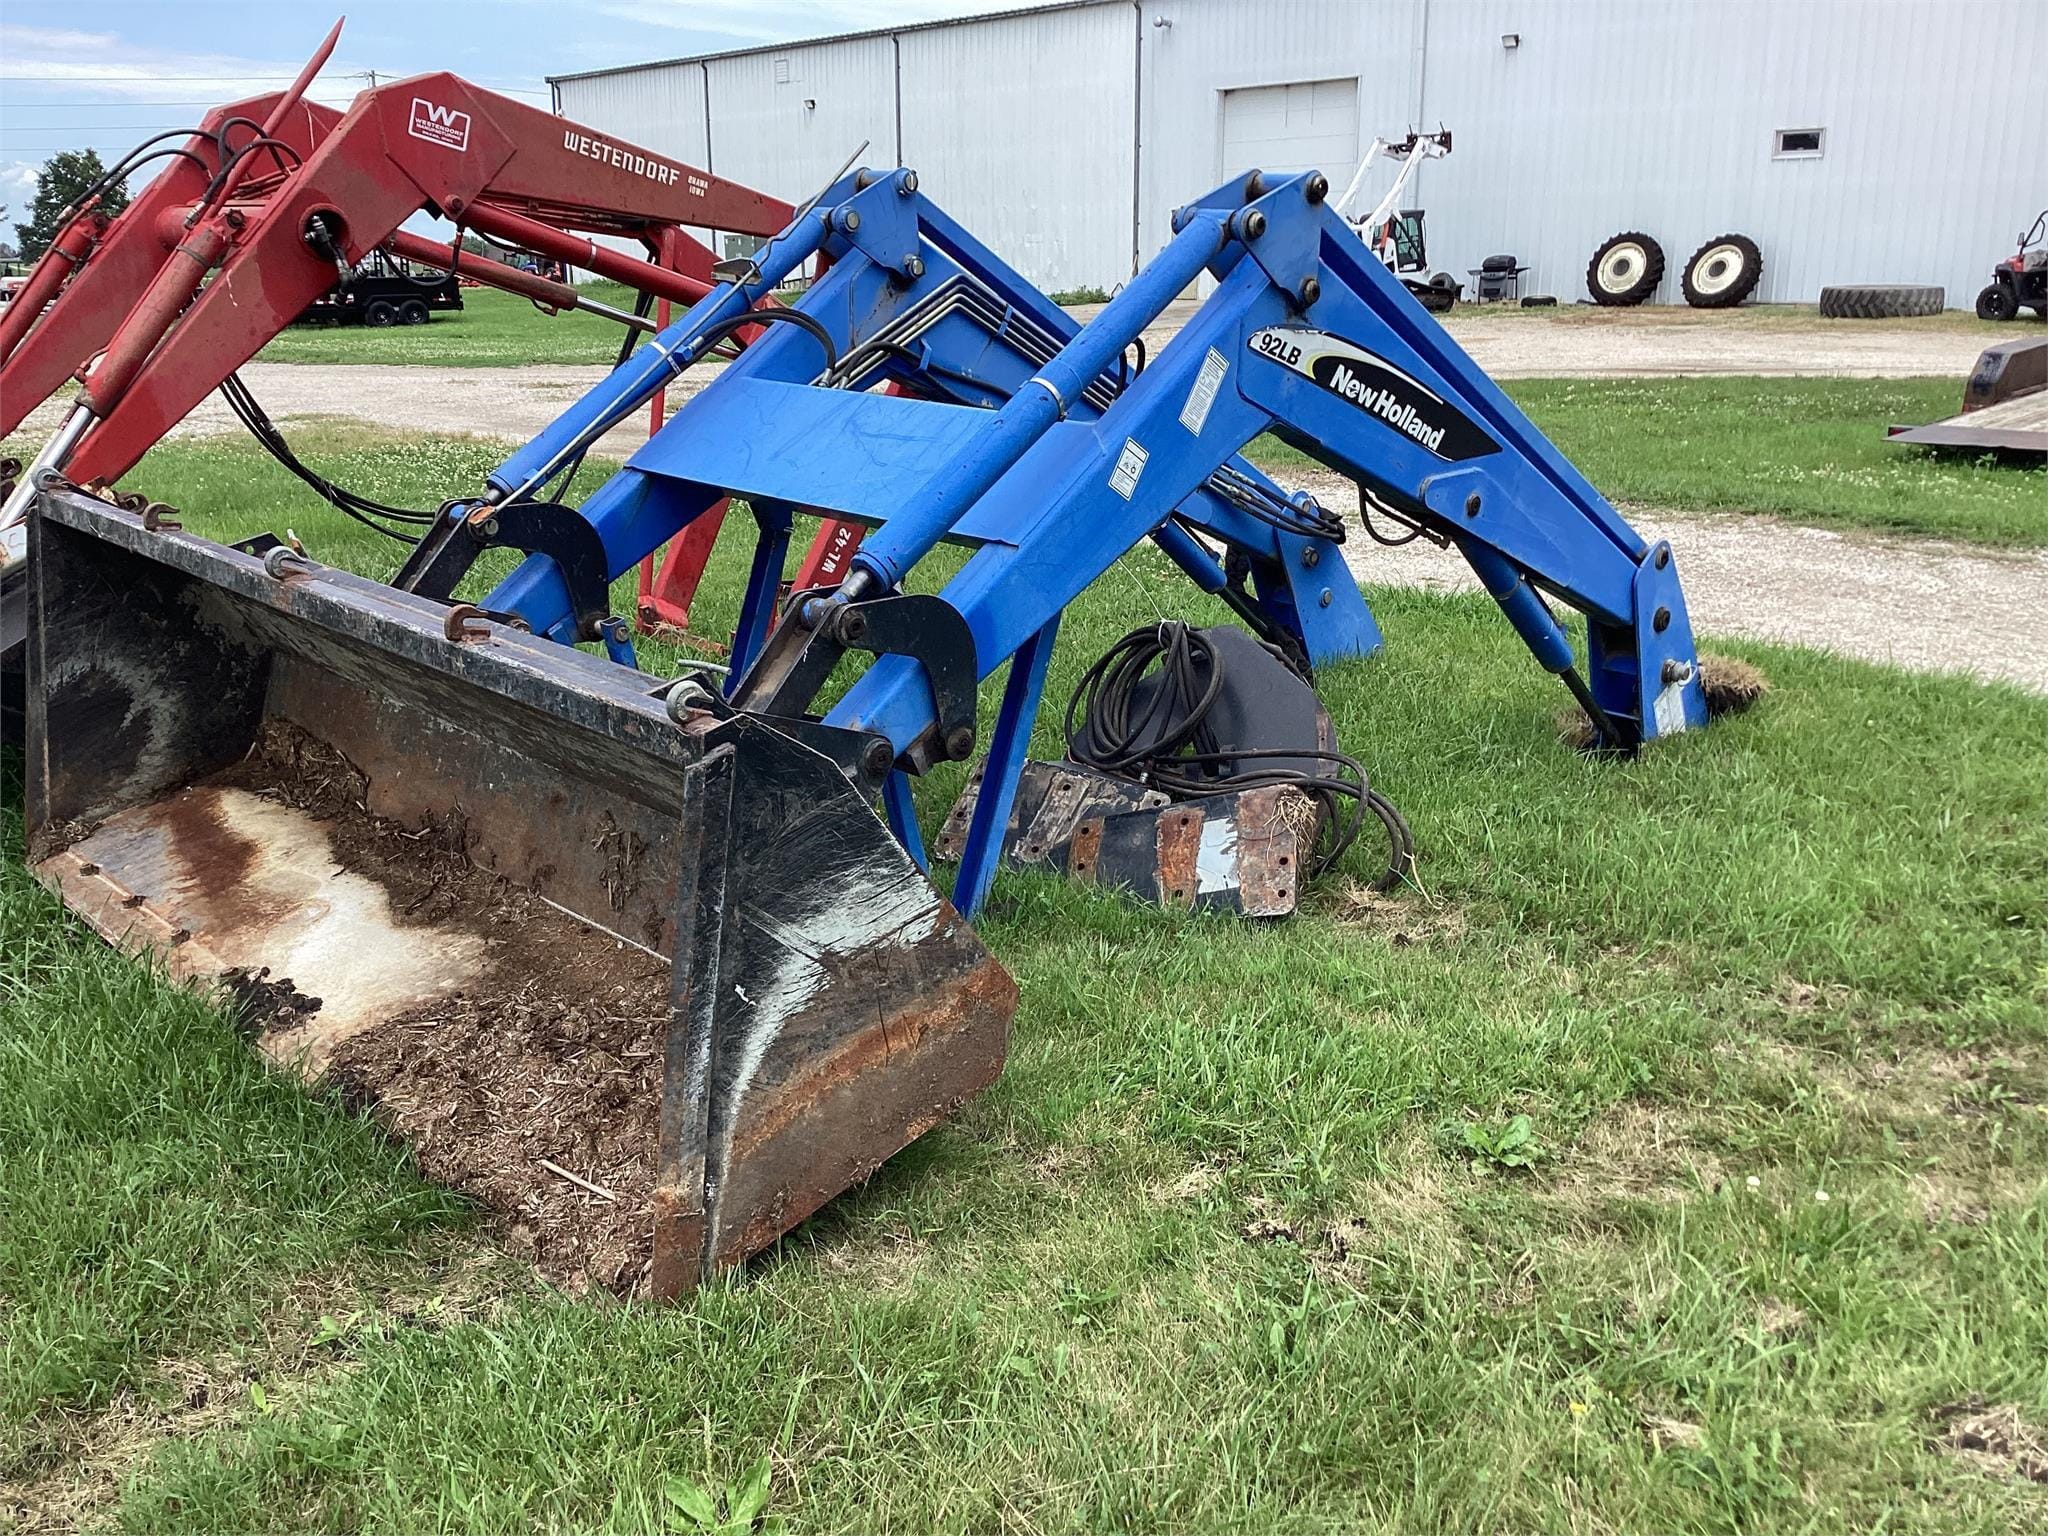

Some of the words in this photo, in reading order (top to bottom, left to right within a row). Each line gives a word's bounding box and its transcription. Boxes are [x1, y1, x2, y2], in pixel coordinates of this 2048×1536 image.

[415, 116, 465, 137] WESTENDORF
[563, 130, 681, 187] WESTENDORF
[689, 185, 705, 198] IOWA
[1259, 333, 1302, 366] 92LB
[821, 527, 852, 574] WL-42
